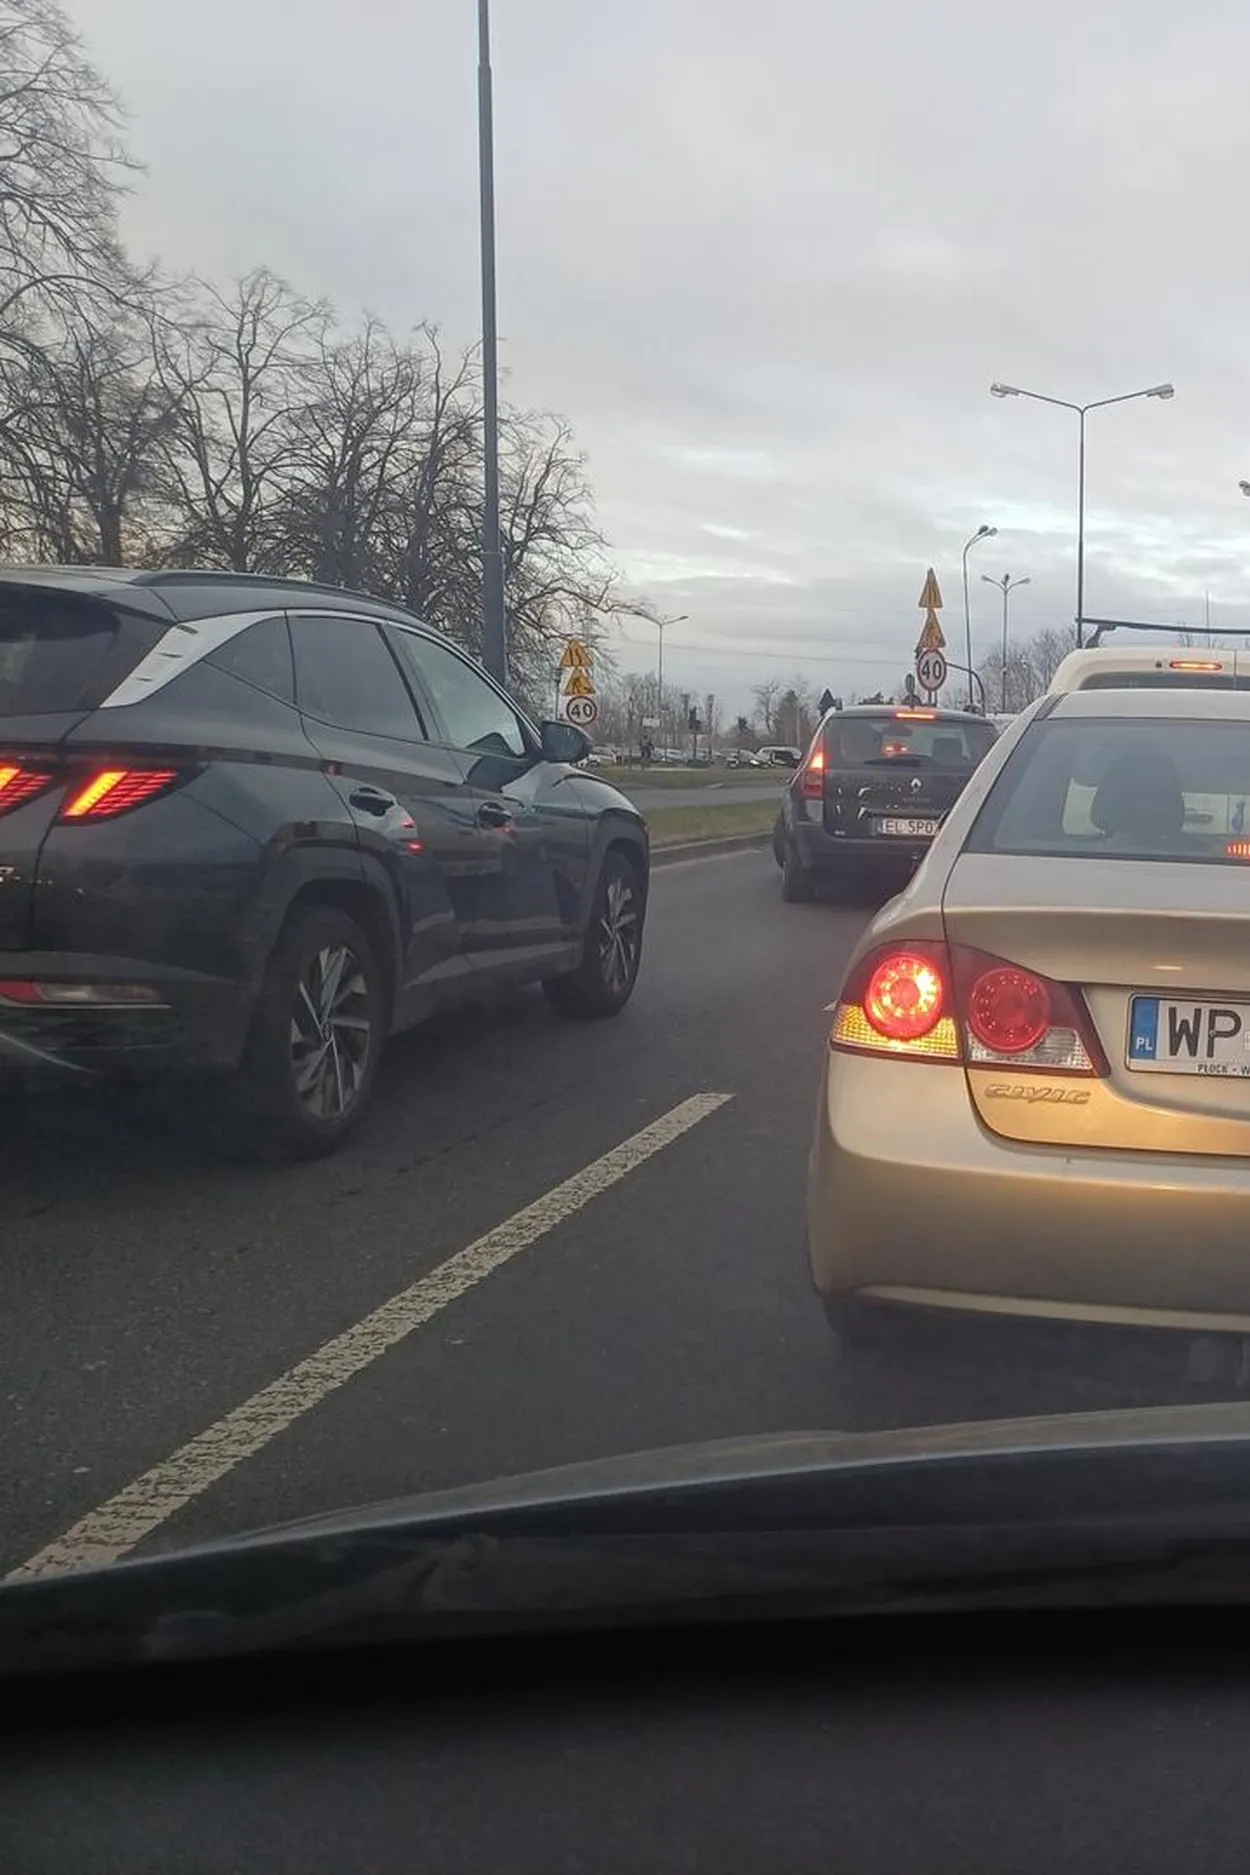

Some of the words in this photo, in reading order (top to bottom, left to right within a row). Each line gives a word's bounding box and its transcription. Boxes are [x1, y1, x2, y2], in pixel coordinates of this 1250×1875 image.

[922, 660, 942, 680] 40
[571, 703, 592, 718] 40
[884, 820, 901, 834] EL
[1168, 1006, 1242, 1058] WP
[1135, 1036, 1153, 1051] PL
